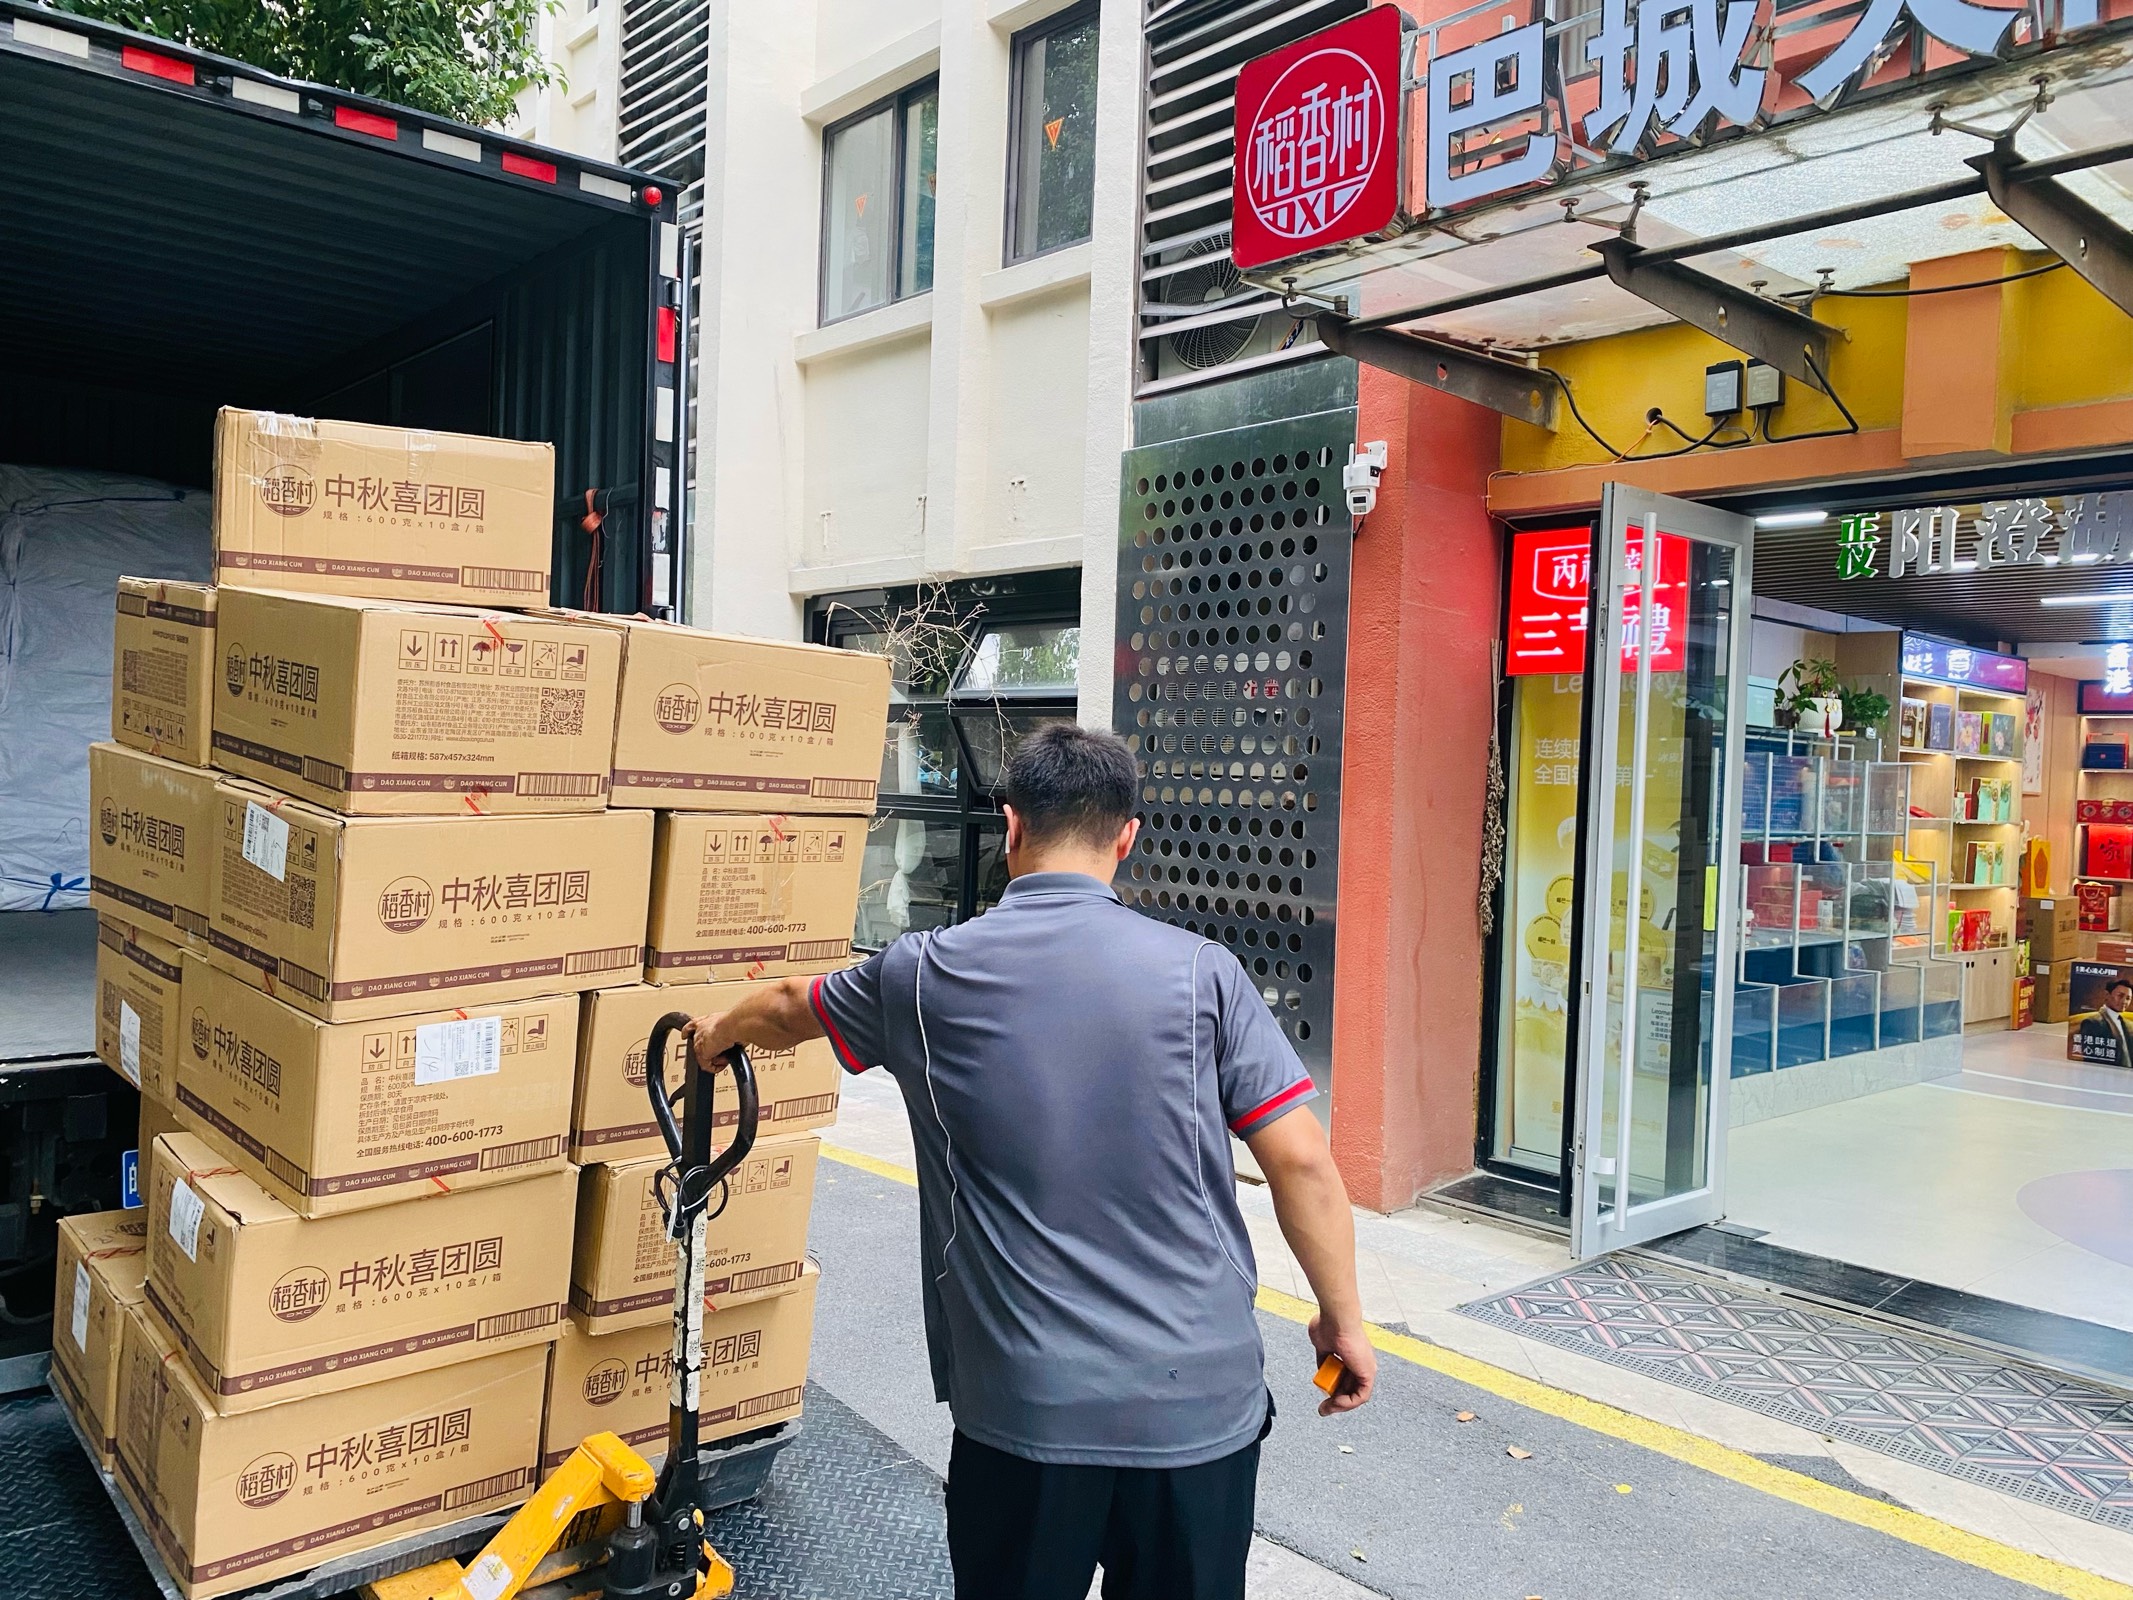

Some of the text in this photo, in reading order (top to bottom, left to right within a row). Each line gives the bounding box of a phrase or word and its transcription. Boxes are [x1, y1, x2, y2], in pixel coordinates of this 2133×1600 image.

[1254, 79, 1373, 202] 稻香村
[262, 476, 313, 505] 稻香村
[324, 474, 485, 521] 中秋喜团圆
[253, 558, 303, 568] DAO XIANG CUN
[332, 564, 380, 574] DAO XIANG CUN
[407, 569, 454, 579] DAO XIANG CUN
[249, 652, 319, 704] 中秋喜团圆
[656, 694, 699, 723] 稻香村
[708, 691, 837, 734] 中秋喜团圆
[380, 778, 431, 788] DAO XIANG CUN
[459, 779, 509, 789] DAO XIANG CUN
[121, 807, 185, 860] 中秋喜团圆
[440, 869, 590, 915] 中秋喜团圆
[381, 888, 433, 920] 稻香村
[747, 923, 807, 935] 400-600-1773
[368, 984, 382, 992] DAO
[383, 982, 403, 990] XIANG
[444, 975, 458, 983] DAO
[459, 973, 477, 981] XIANG
[214, 1023, 282, 1099] 中秋喜团圆
[425, 1125, 504, 1147] 400-600-1773
[622, 1129, 639, 1137] XIANG
[639, 1127, 651, 1135] CUN
[440, 1162, 458, 1171] XIANG
[338, 1235, 504, 1298] 中秋喜团圆
[272, 1276, 328, 1312] 稻香村
[623, 1295, 663, 1308] DAO XIANG CUN
[422, 1329, 470, 1346] DAO XIANG CUN
[343, 1346, 394, 1364] DAO XIANG CUN
[259, 1365, 313, 1384] DAO XIANG CUN
[585, 1368, 626, 1397] 稻香村
[305, 1407, 472, 1480] 中秋喜团圆
[240, 1462, 295, 1499] 稻香村
[388, 1501, 436, 1520] DAO XIANG CUN
[309, 1523, 360, 1544] DAO XIANG CUN
[225, 1548, 279, 1569] DAO XIANG CUN
